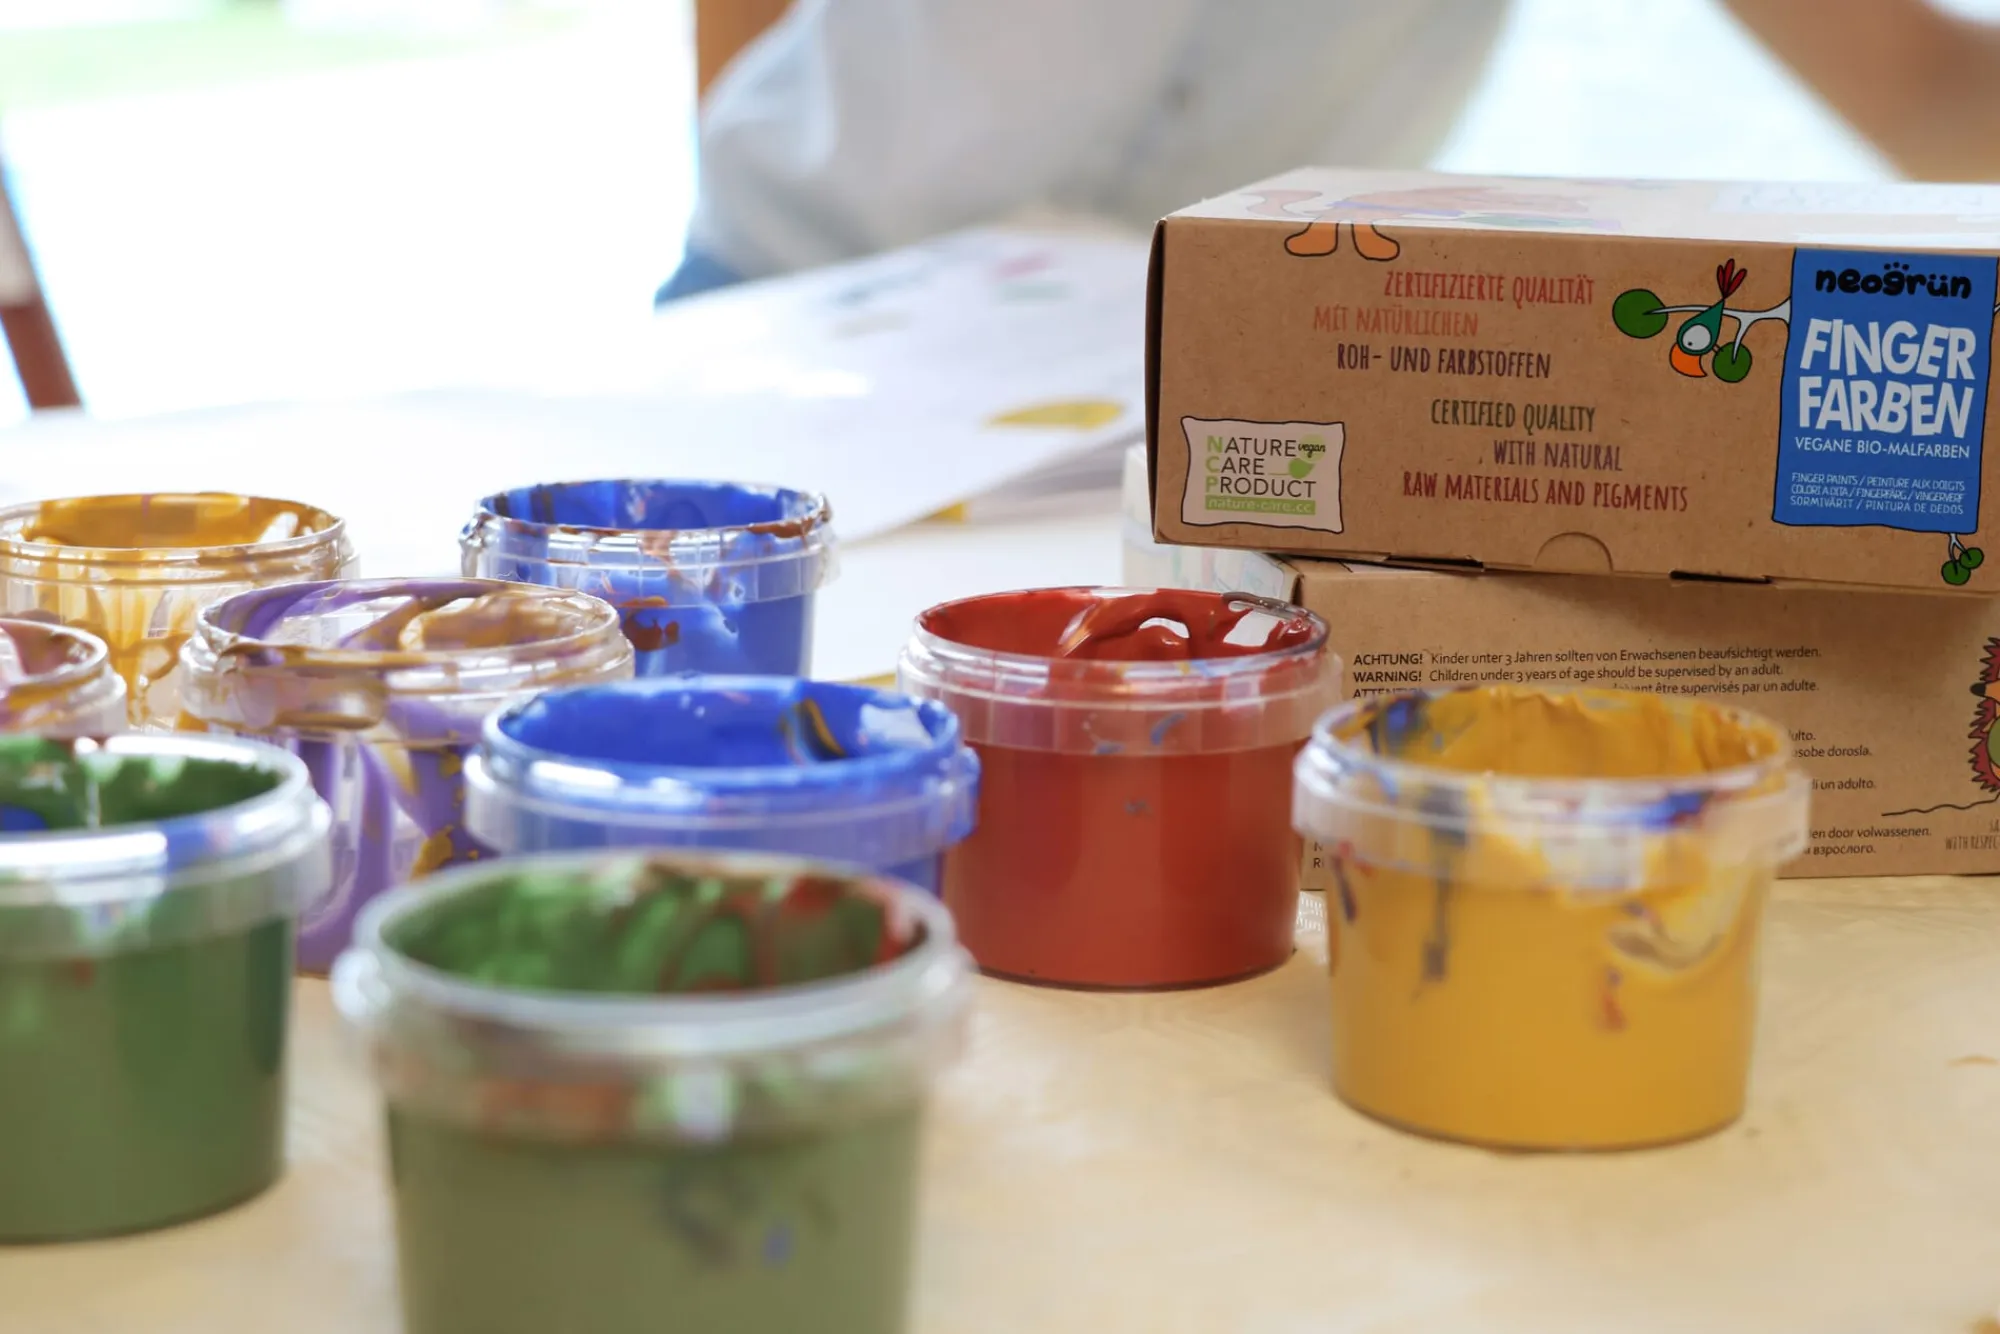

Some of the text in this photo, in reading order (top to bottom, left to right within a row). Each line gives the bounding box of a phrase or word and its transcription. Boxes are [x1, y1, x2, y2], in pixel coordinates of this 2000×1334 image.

[1384, 271, 1595, 309] ZERTIFIZIERTE QUALITÄT
[1816, 262, 1972, 299] neogrün
[1313, 303, 1478, 337] MIT NATÜRLICHEN
[1800, 318, 1977, 380] FINGER
[1337, 343, 1551, 378] ROH- UND FARBSTOFFEN
[1431, 399, 1596, 436] CERTIFIED QUALITY
[1799, 376, 1974, 438] FARBEN
[1207, 435, 1326, 458] NATURE vegan
[1493, 440, 1623, 472] WITH NATURAL
[1795, 437, 1970, 459] VEGANE BIO-MALFARBEN
[1206, 456, 1265, 475] CARE
[1206, 476, 1316, 498] PRODUCT
[1403, 471, 1689, 512] RAW MATERIALS AND PIGMENTS
[1792, 472, 1825, 484] FINGER
[1826, 474, 1858, 486] PAINTS
[1867, 476, 1909, 488] PEINTURE
[1911, 479, 1931, 490] AUX
[1932, 480, 1965, 492] DOIGTS
[1208, 497, 1312, 513] nature-care.cc
[1865, 500, 1911, 512] PINTURA
[1914, 502, 1926, 513] DE
[1930, 503, 1964, 515] DEDOS
[1353, 647, 1822, 666] ACHTUNG! Kinder unter 3 Jahren sollten von Erwachsenen beaufsichtigt werden.
[1353, 665, 1783, 683] WARNING! Children under 3 years of age should be supervised by an adult.
[1655, 682, 1679, 694] être
[1681, 681, 1740, 696] supervisés
[1742, 684, 1760, 696] par
[1763, 683, 1779, 692] un
[1780, 679, 1819, 692] adulte.
[1820, 780, 1836, 790] un
[1828, 827, 1854, 839] door
[1857, 825, 1932, 838] volwassenen.
